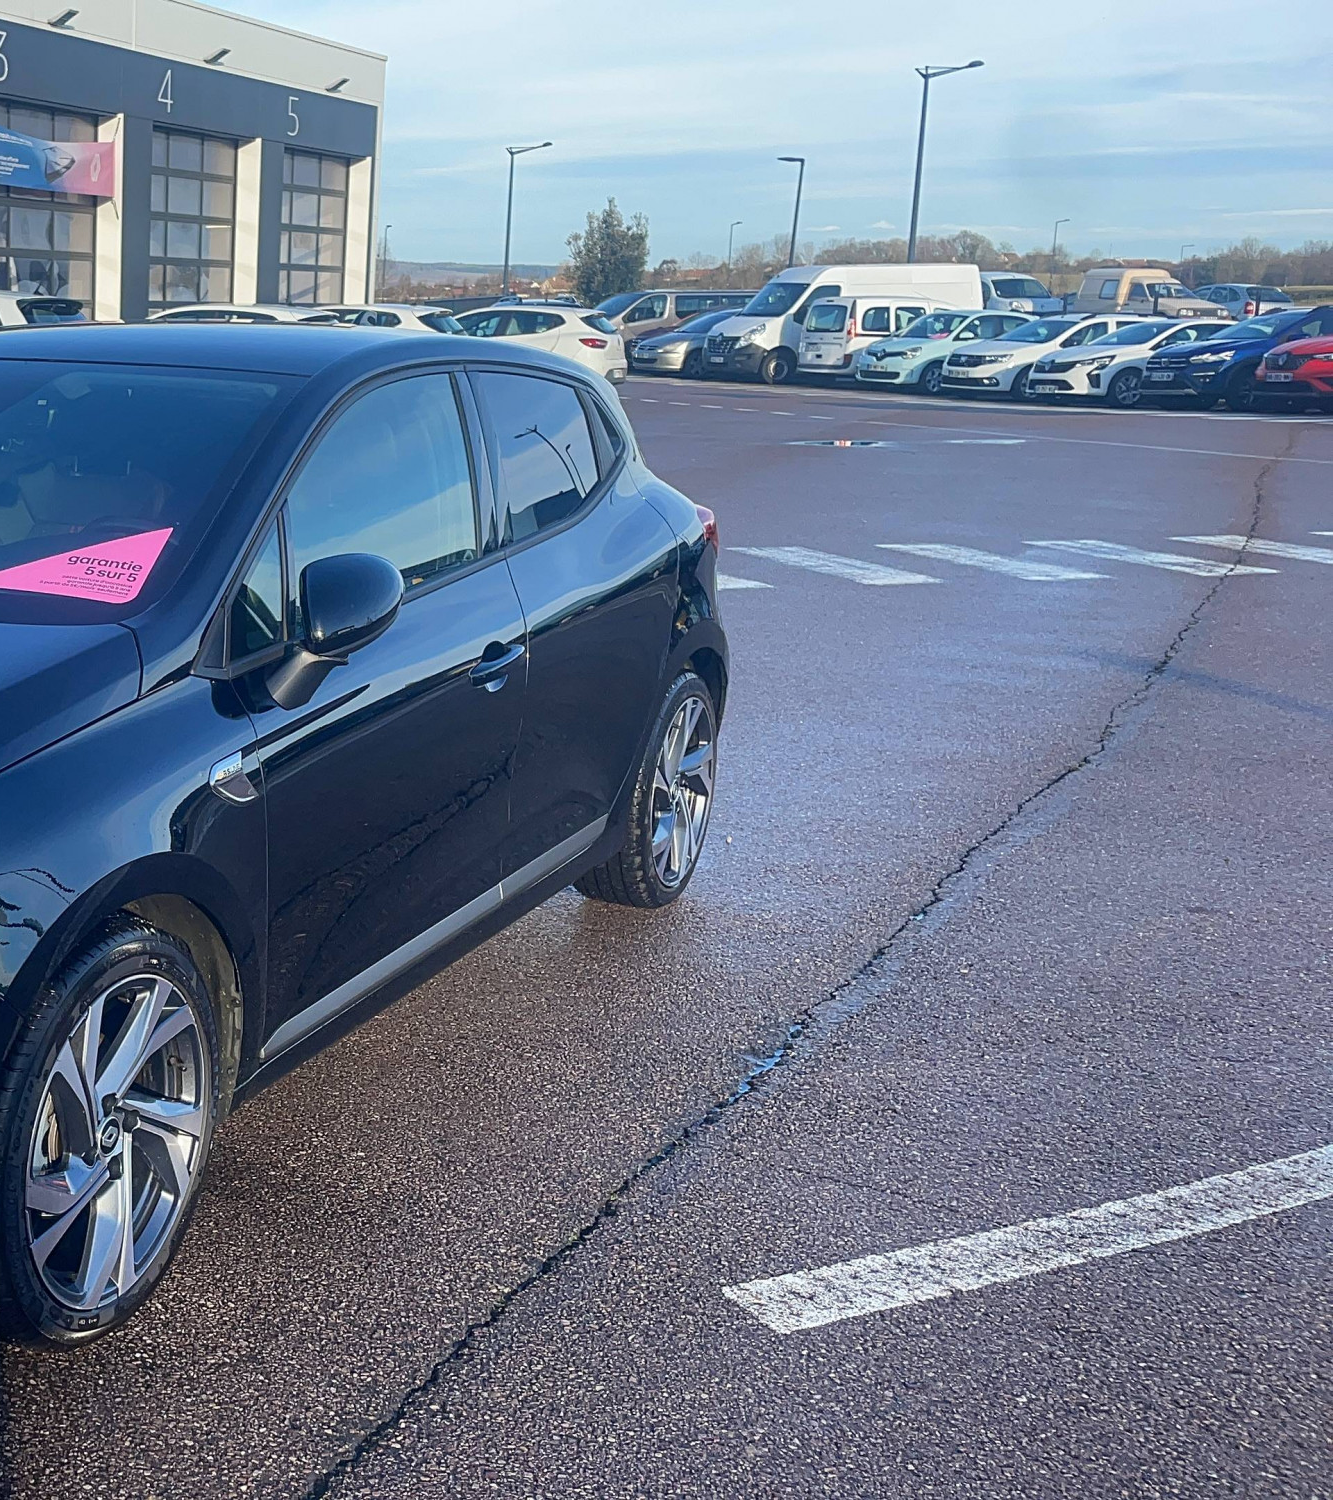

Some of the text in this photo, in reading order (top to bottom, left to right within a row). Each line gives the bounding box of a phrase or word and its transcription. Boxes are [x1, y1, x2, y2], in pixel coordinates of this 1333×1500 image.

[157, 69, 174, 113] 4
[286, 96, 300, 136] 5
[67, 555, 143, 572] garantie
[84, 566, 139, 583] 5 sur 5
